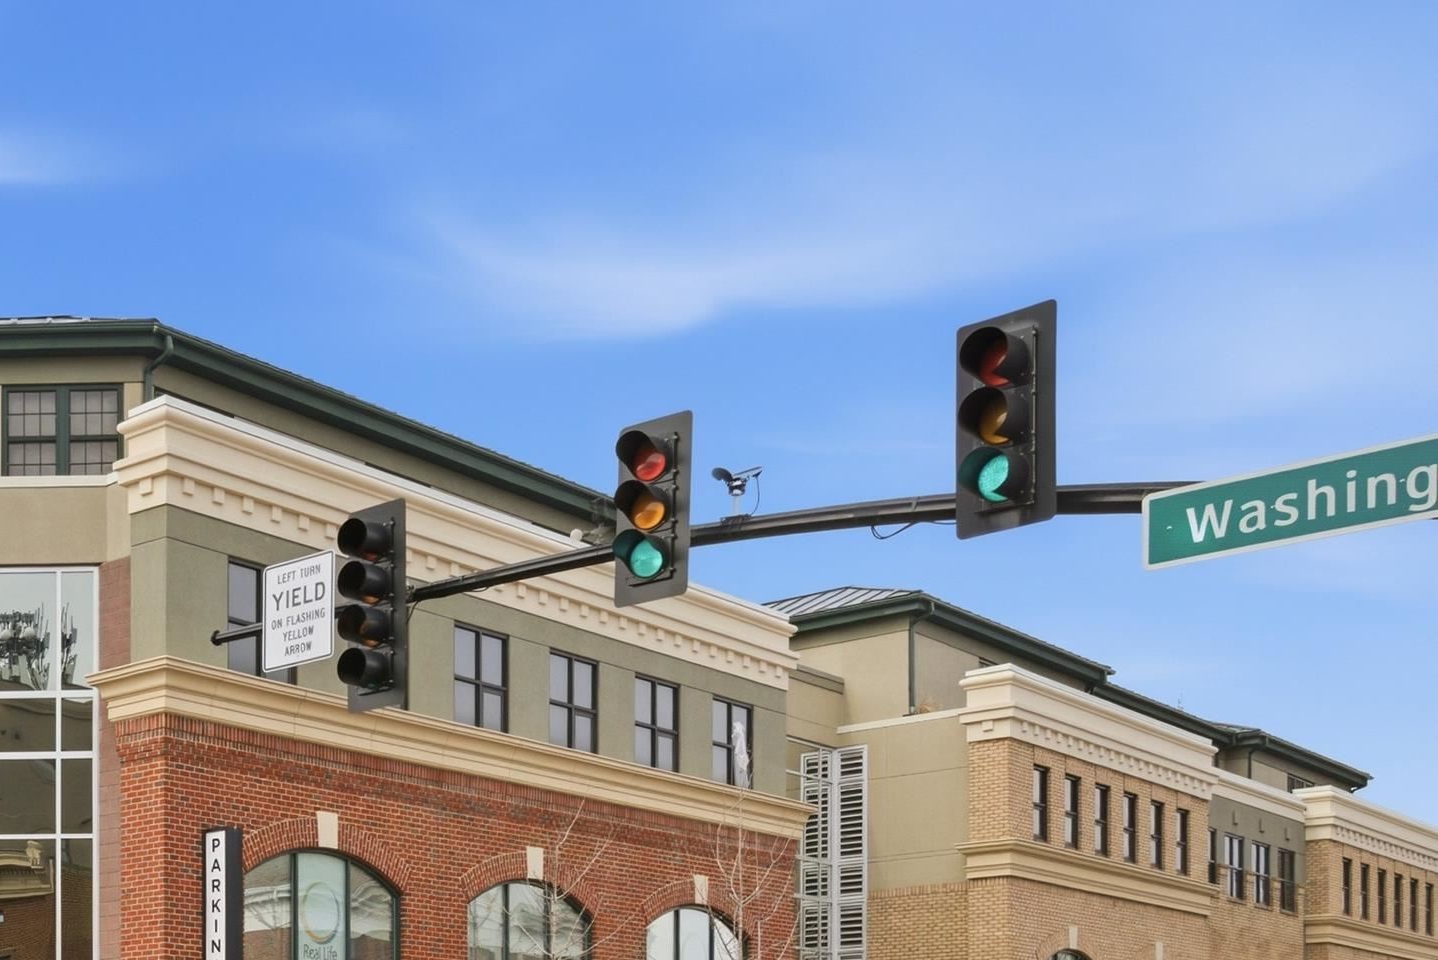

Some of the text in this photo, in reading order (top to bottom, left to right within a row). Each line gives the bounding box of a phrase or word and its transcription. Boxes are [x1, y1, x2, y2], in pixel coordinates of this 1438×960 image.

[1186, 463, 1438, 543] Washing
[277, 564, 321, 585] LEFT TURN
[272, 582, 326, 612] YIELD
[271, 607, 326, 631] ON FLASHING
[282, 625, 315, 642] YELLOW
[284, 641, 312, 657] ARROW
